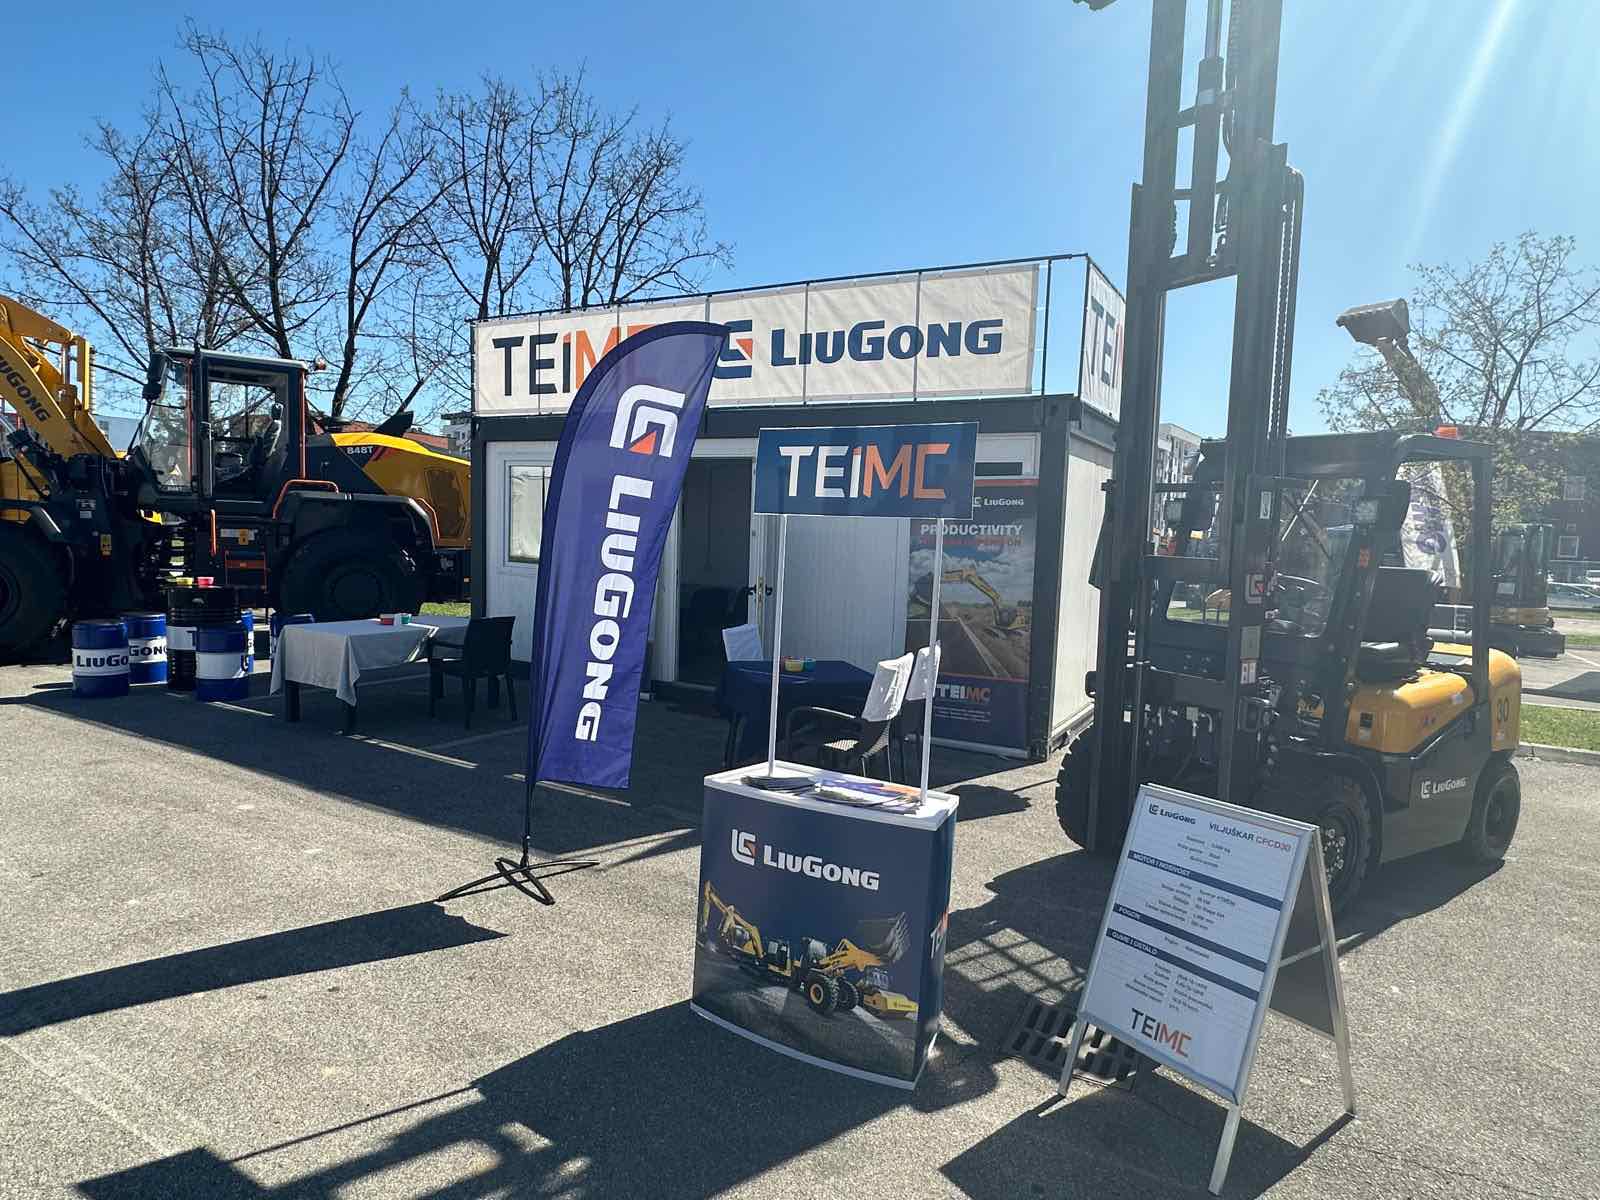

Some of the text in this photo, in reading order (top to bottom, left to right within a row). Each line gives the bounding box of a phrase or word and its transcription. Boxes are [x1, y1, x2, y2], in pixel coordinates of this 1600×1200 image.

[346, 446, 374, 455] 848T
[778, 443, 951, 501] TEIMC
[920, 524, 1023, 536] PRODUCTIVITY
[1131, 1007, 1192, 1058] TEIMC
